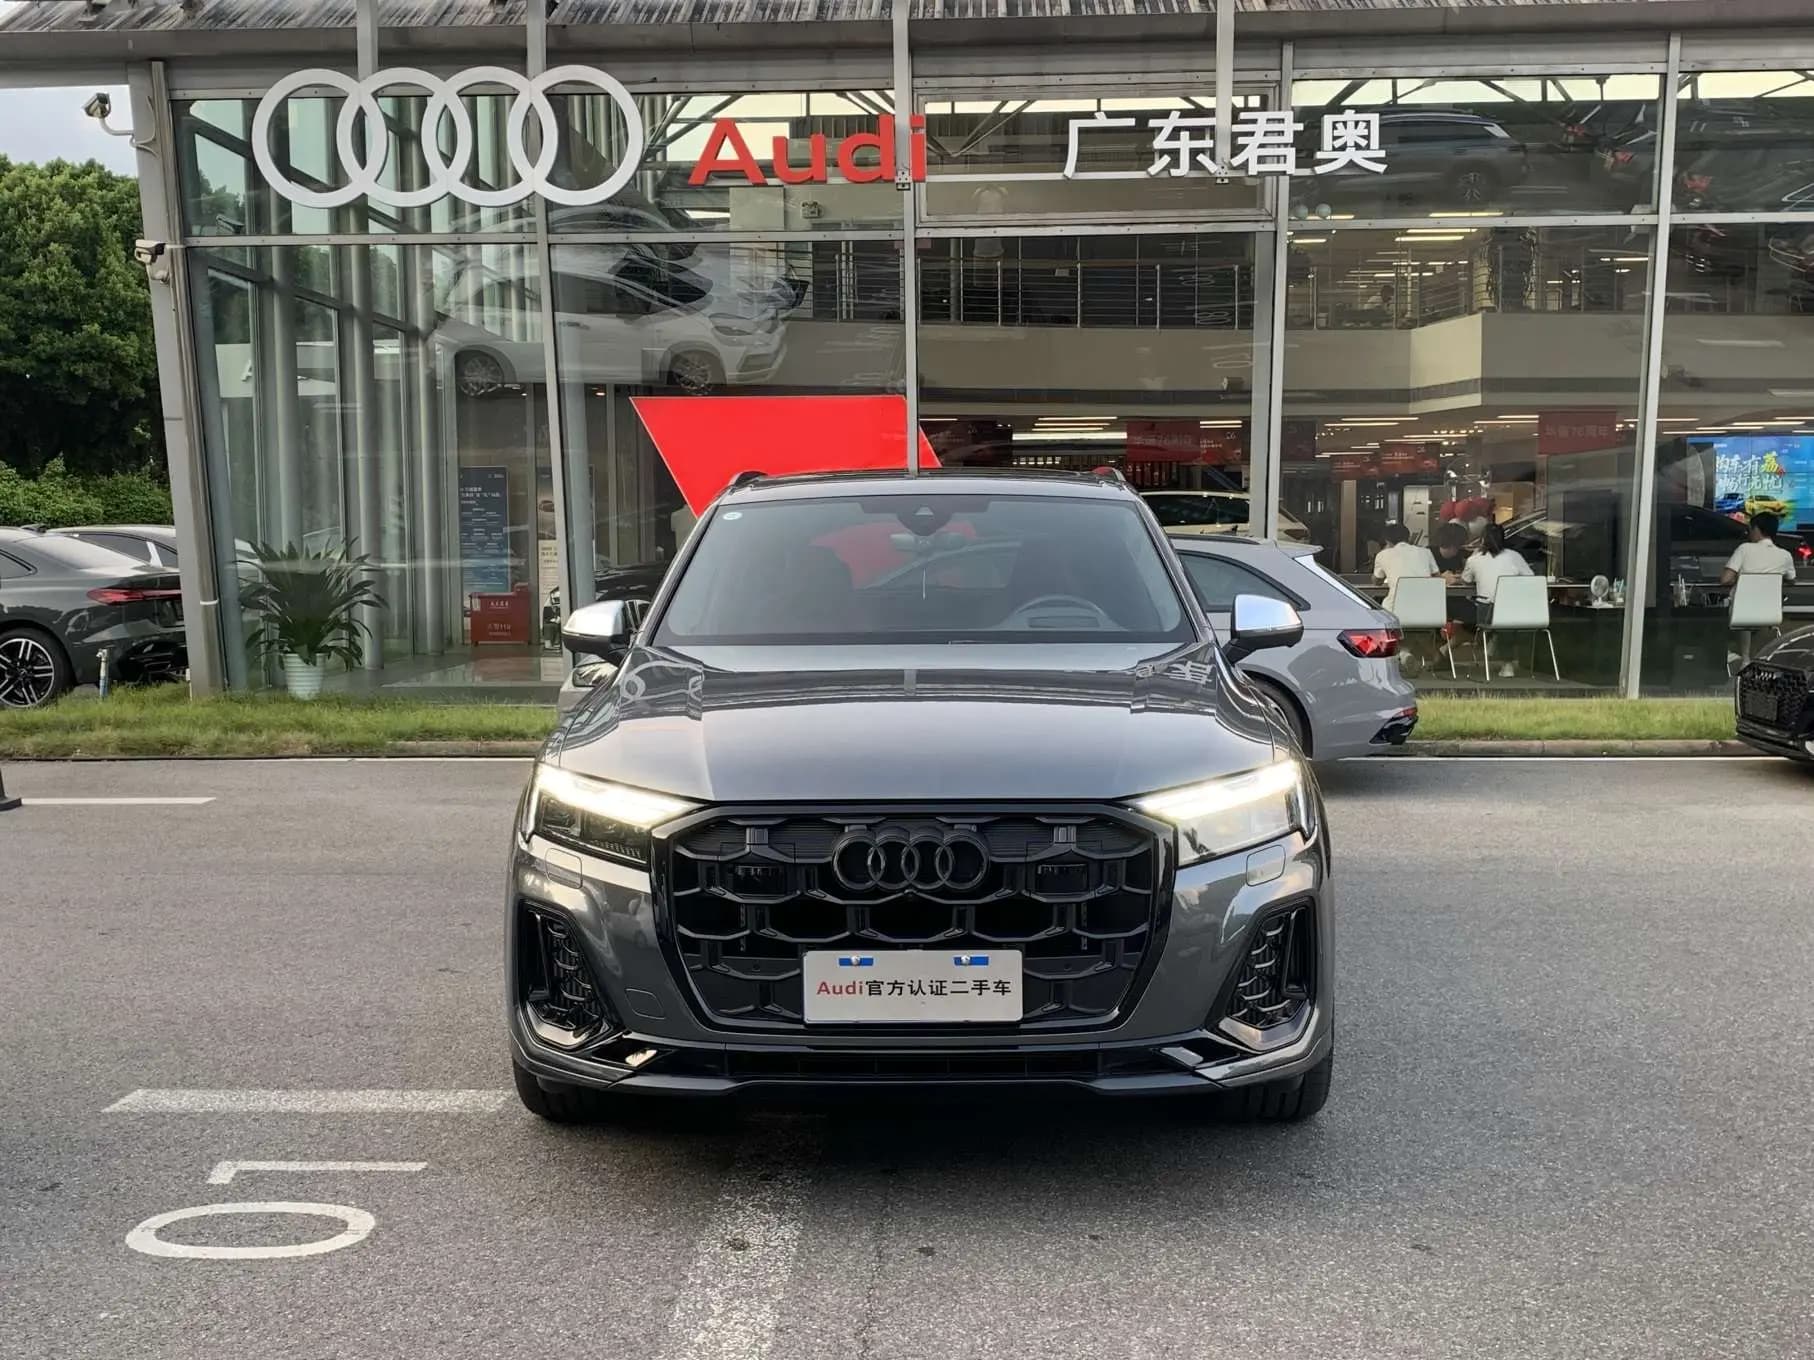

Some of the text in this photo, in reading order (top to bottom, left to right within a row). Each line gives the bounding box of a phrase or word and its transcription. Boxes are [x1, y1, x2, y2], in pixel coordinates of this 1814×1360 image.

[688, 113, 926, 186] Audi
[1062, 109, 1388, 179] 广东君奥
